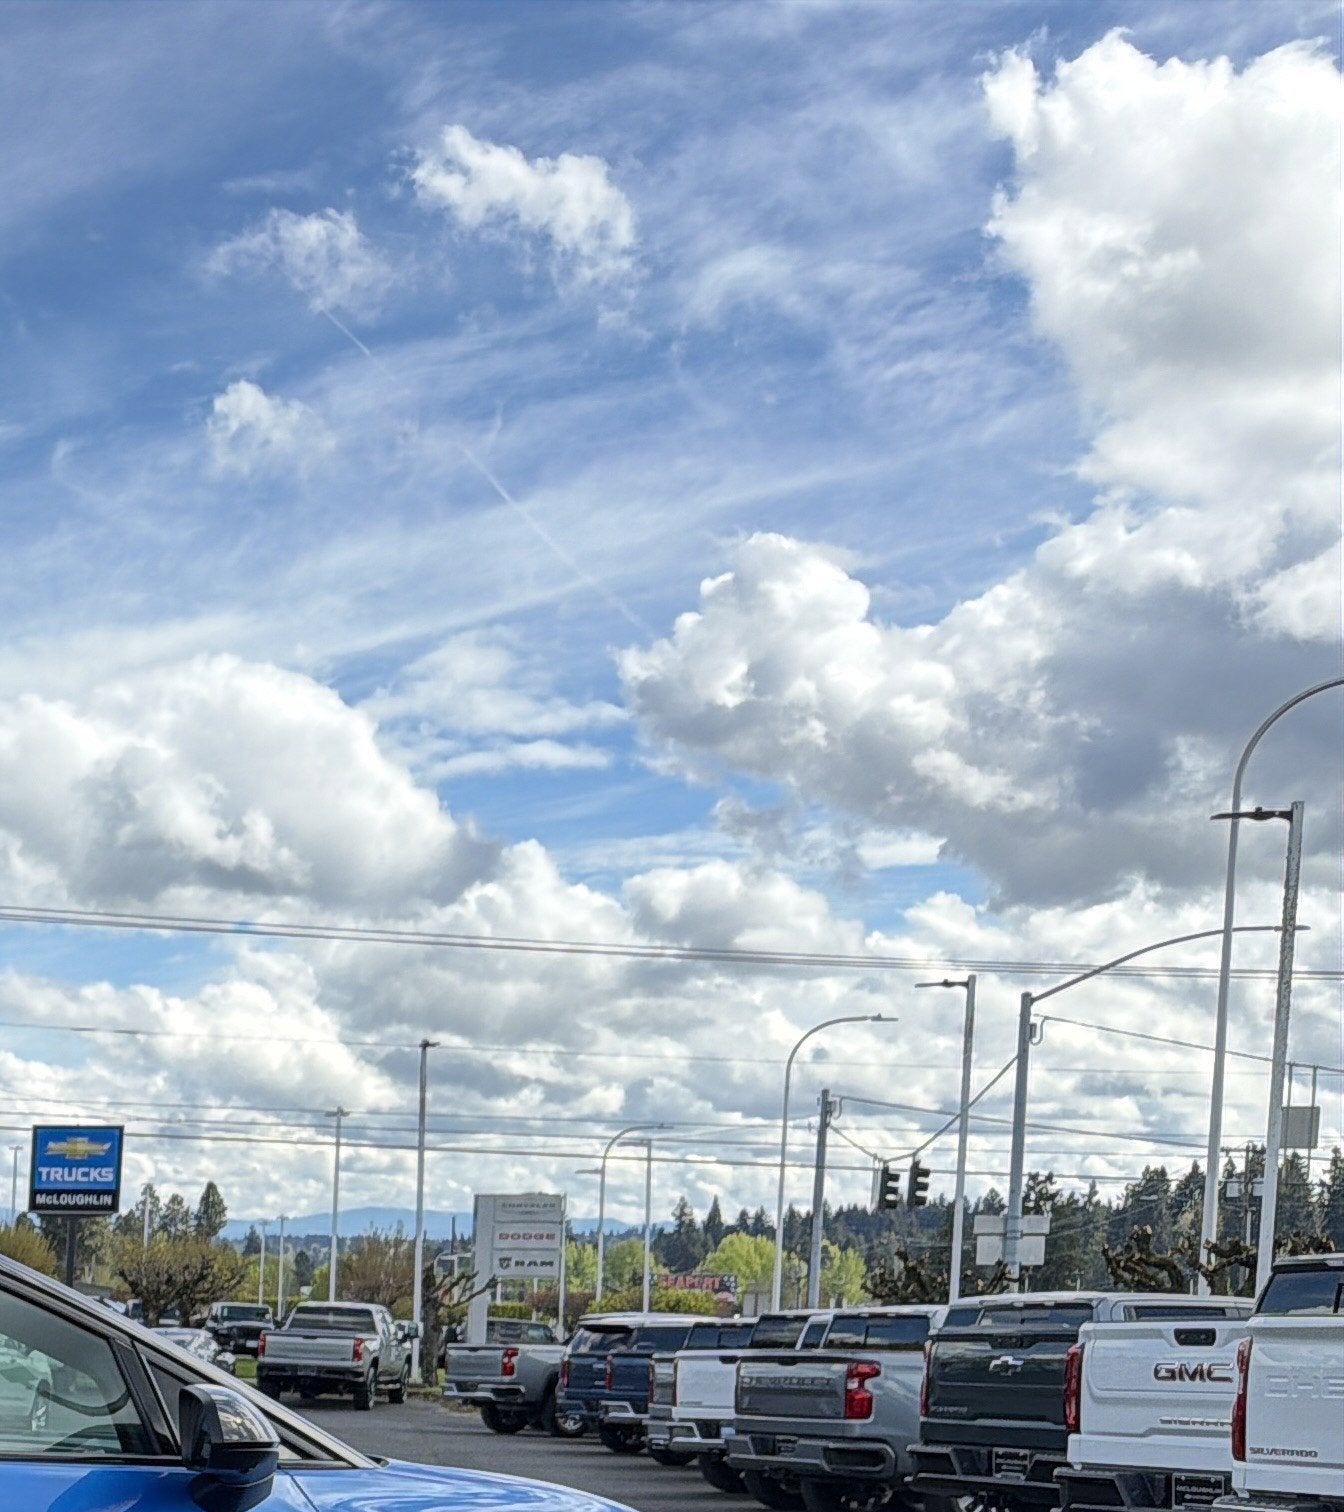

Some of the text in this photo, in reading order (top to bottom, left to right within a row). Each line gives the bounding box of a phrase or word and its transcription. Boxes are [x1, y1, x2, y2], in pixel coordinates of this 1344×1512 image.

[37, 1166, 114, 1183] TRUCKS
[35, 1192, 114, 1206] McLOUGHLIN
[498, 1231, 556, 1241] DODGE
[514, 1260, 555, 1268] RAM
[1153, 1361, 1235, 1383] GMC
[1248, 1446, 1319, 1459] SILVERADO
